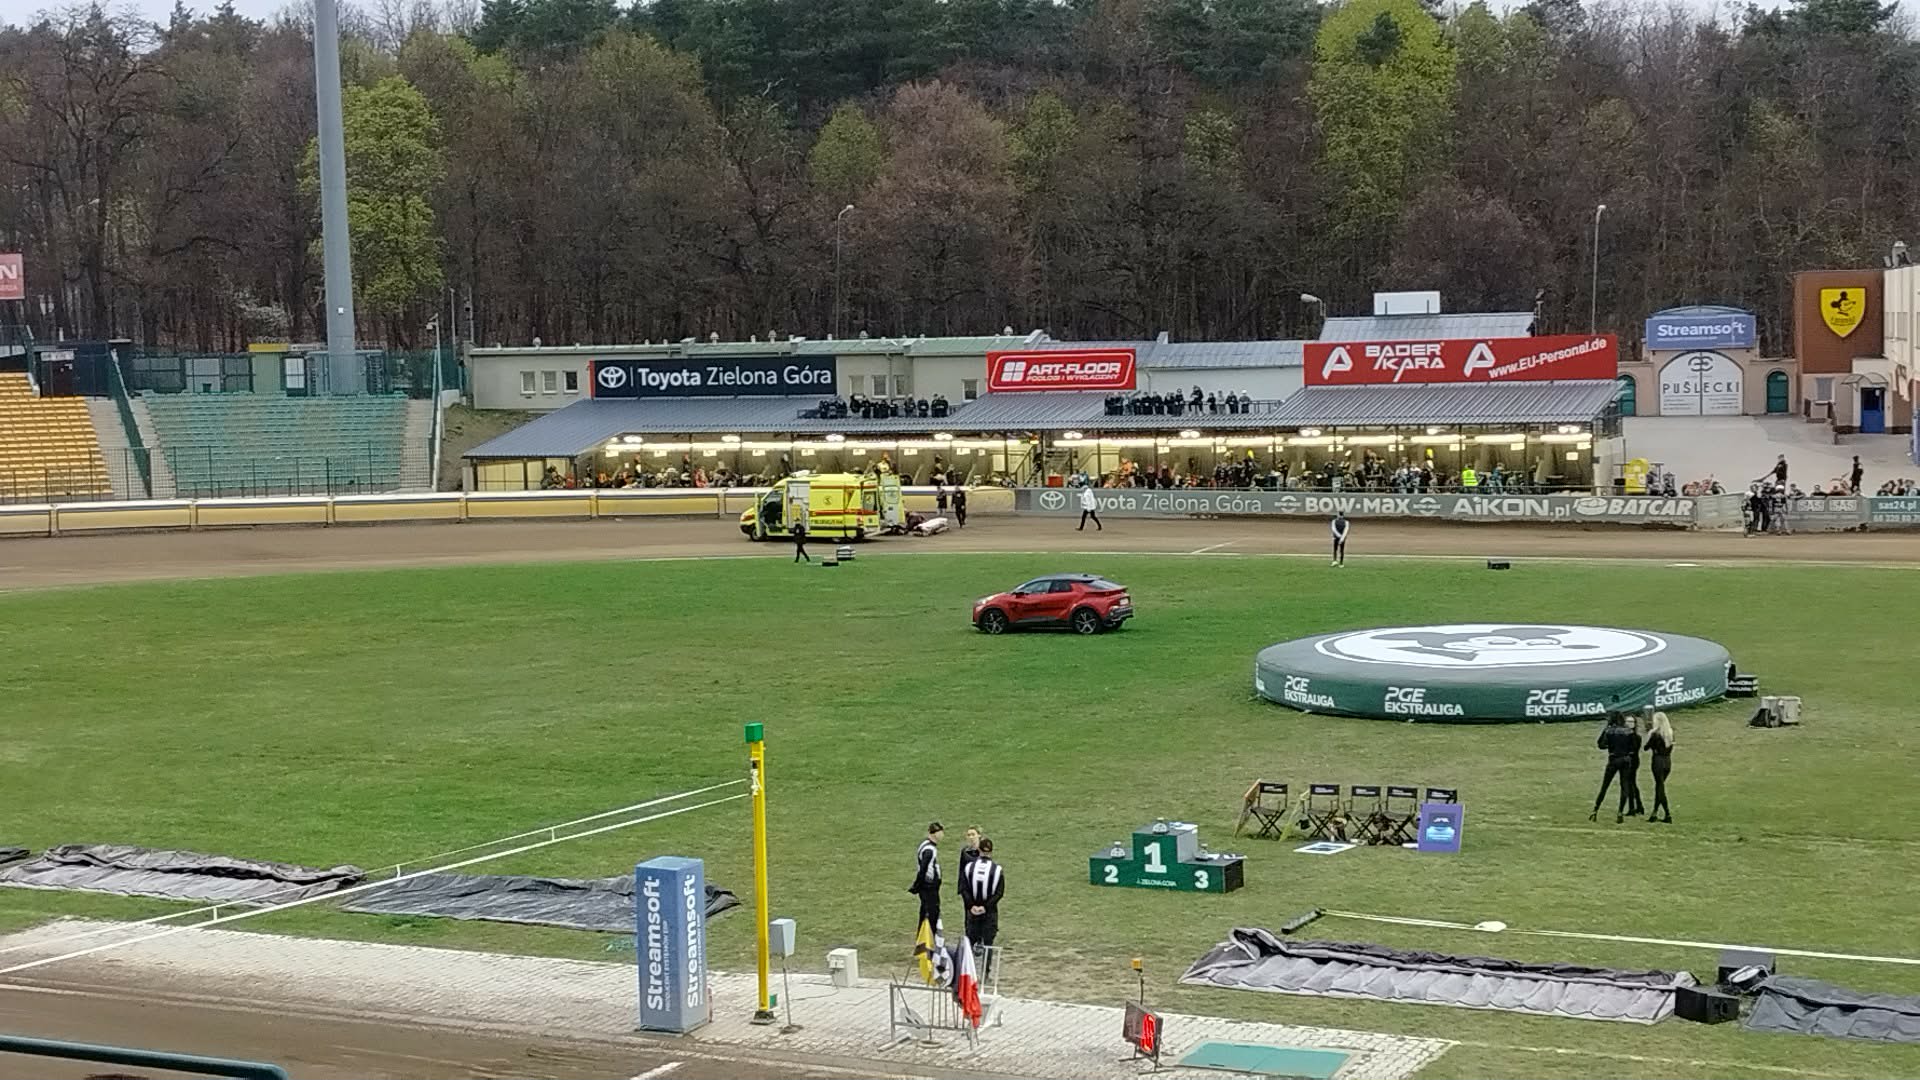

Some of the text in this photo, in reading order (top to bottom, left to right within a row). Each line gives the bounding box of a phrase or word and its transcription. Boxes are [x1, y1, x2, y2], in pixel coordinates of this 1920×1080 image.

[1657, 321, 1746, 336] Streamsoft
[1365, 343, 1441, 362] BADER
[1488, 338, 1607, 378] www.EU-Personal.de
[1026, 363, 1122, 375] ART-FLOOR
[1381, 357, 1445, 377] KARA
[637, 364, 832, 390] Toyota Zielona Góra
[1076, 493, 1262, 512] yota Zielona Góra
[1607, 498, 1694, 516] BATCAR
[1284, 675, 1311, 692] PGE
[1654, 676, 1685, 695] PGE
[1284, 688, 1335, 708] EKSTRALIGA
[1384, 686, 1427, 703] PGE
[1526, 688, 1571, 705] PGE
[1654, 687, 1706, 707] EKSTRALIGA
[1384, 701, 1465, 716] EKSTRALIGA
[1525, 702, 1607, 717] EKSTRALIGA
[1143, 841, 1167, 874] 1
[1103, 864, 1119, 884] 2
[1194, 869, 1209, 889] 3
[643, 875, 663, 1011] Streamsoft
[683, 874, 698, 1009] Streamsoft
